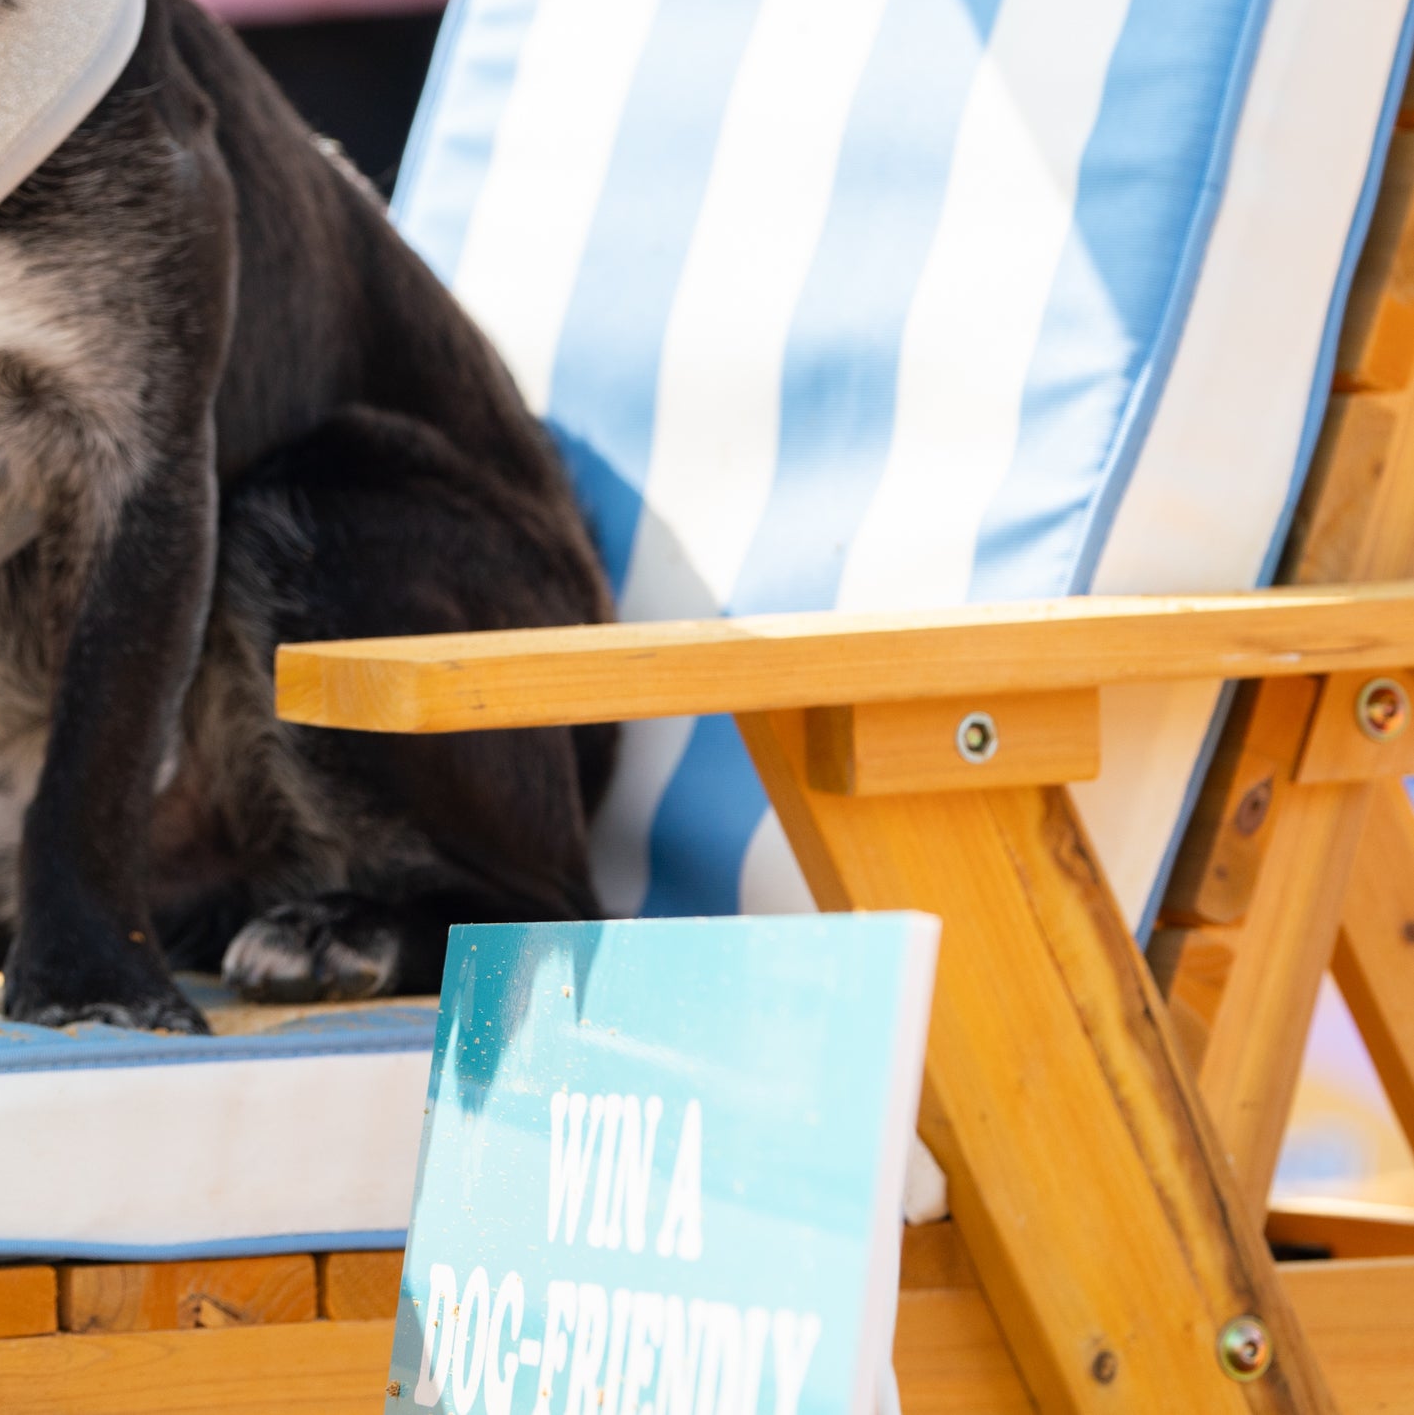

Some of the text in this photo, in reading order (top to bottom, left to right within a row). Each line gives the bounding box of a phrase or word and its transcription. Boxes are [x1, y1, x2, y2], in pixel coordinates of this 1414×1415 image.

[547, 1091, 703, 1262] WIN A
[413, 1262, 823, 1415] DOG-FRIENDLY
